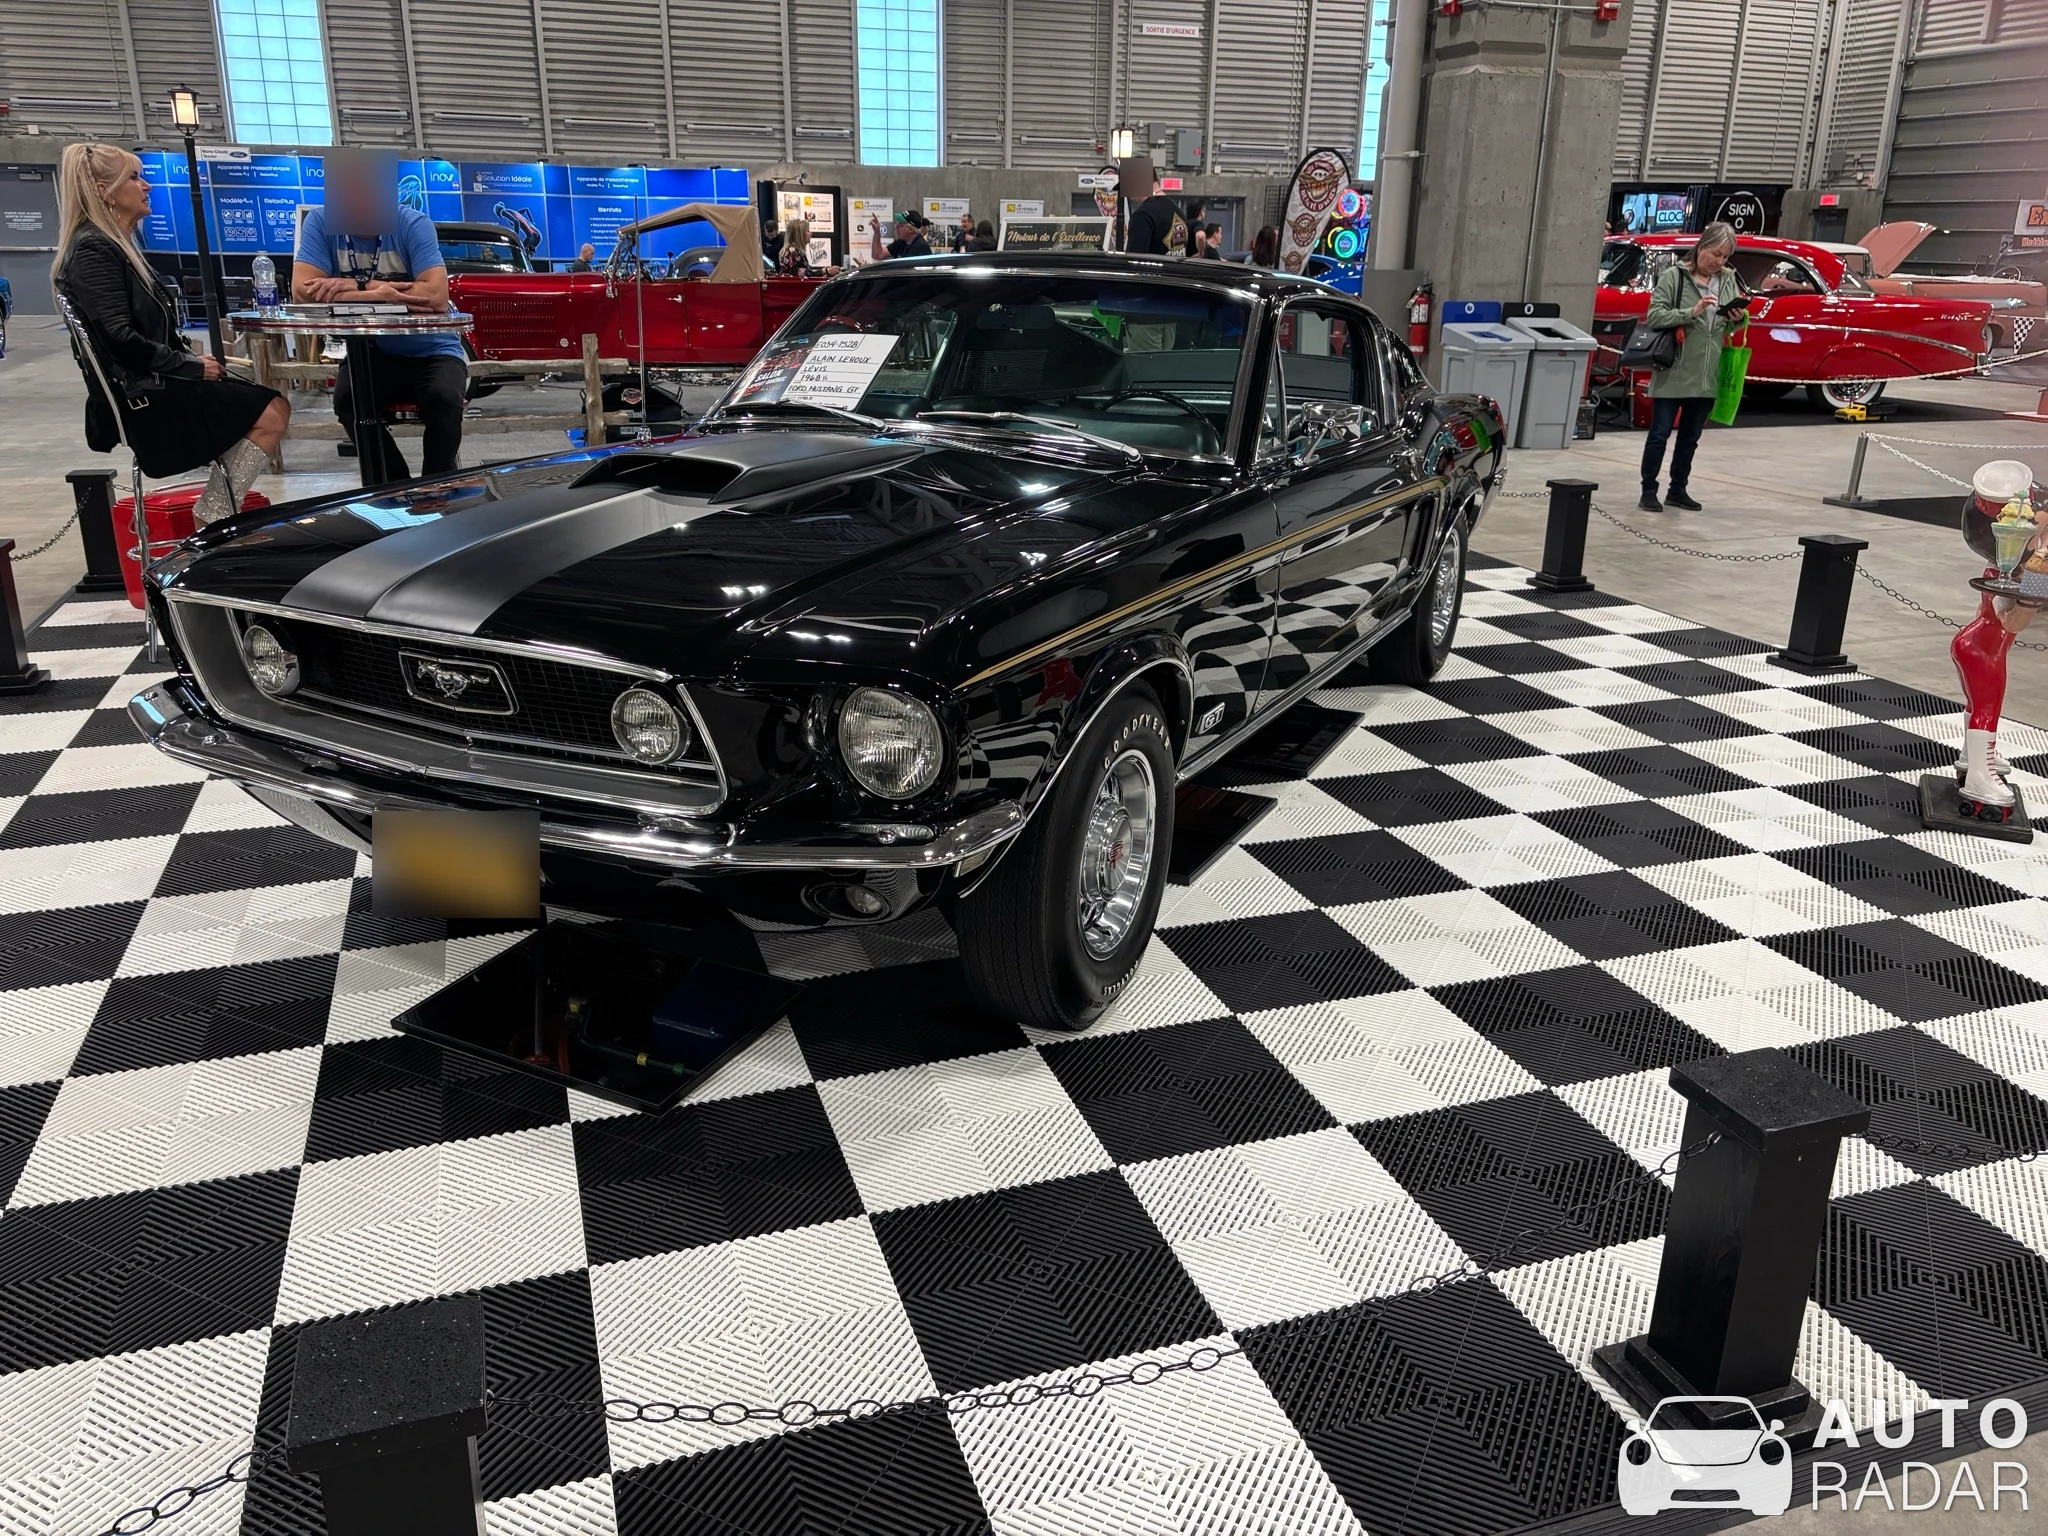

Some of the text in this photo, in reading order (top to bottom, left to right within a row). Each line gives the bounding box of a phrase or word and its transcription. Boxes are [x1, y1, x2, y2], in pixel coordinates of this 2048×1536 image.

[305, 166, 325, 178] ino
[482, 174, 533, 183] Solution Idéale
[1728, 203, 1755, 216] SIGN
[1658, 212, 1685, 222] CLOC
[1735, 217, 1744, 229] O
[1007, 231, 1101, 243] Moteur de l'Excellence
[839, 355, 871, 363] LEHOUX
[809, 385, 843, 393] MUSTANG
[1205, 707, 1224, 729] GT
[1104, 713, 1170, 770] GOODYEAR
